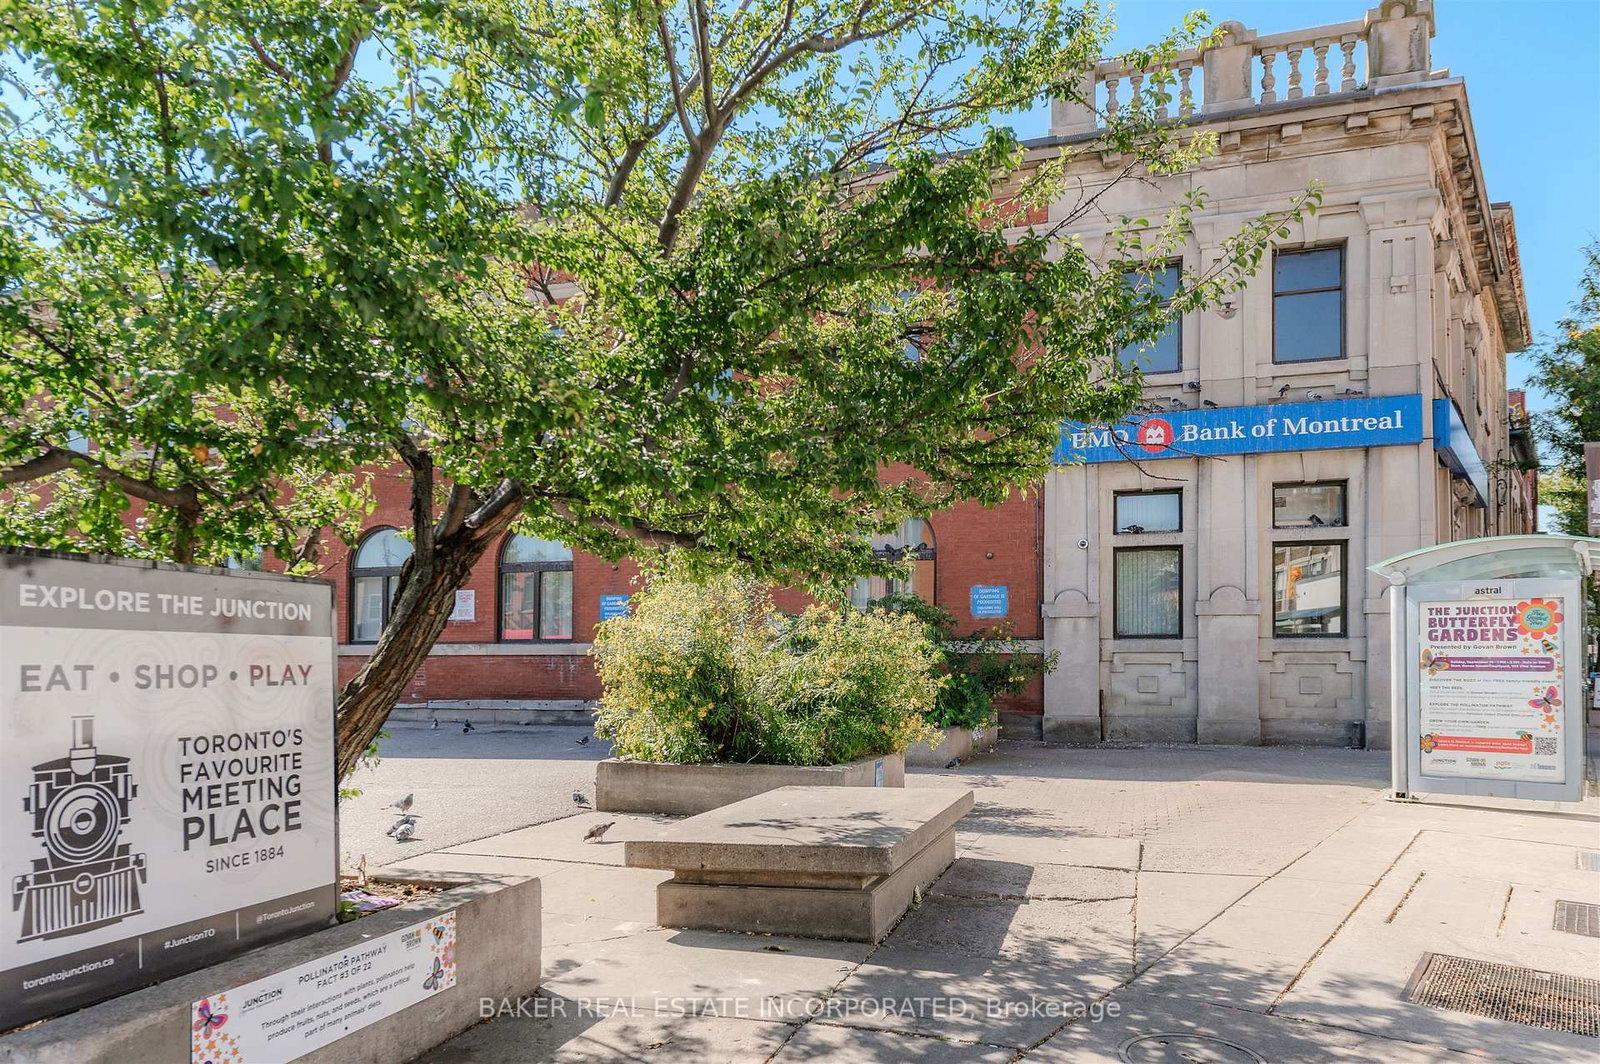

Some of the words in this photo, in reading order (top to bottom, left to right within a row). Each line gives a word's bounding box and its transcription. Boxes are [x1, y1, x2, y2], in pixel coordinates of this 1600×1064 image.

[1182, 421, 1247, 443] Bank
[1252, 418, 1279, 437] of
[1283, 410, 1403, 435] Montreal
[19, 583, 150, 613] EXPLORE
[157, 593, 204, 616] THE
[210, 598, 312, 622] JUNCTION
[1474, 587, 1502, 595] astral
[1428, 607, 1450, 616] THE
[1456, 606, 1517, 616] JUNCTION
[1428, 616, 1517, 628] BUTTERFLY
[1428, 628, 1518, 642] GARDENS
[20, 664, 95, 692] EAT
[134, 664, 218, 690] SHOP
[250, 664, 313, 687] PLAY
[178, 729, 303, 756] TORONTO'S
[180, 752, 302, 783] FAVOURITE
[182, 774, 301, 813] MEETING
[183, 800, 302, 851] PLACE
[206, 852, 250, 874] SINCE
[254, 845, 284, 863] 1884
[255, 900, 316, 924] @TorontoJunction
[164, 928, 216, 951] #JunctionTO
[22, 956, 115, 990] torontojunction.ca
[298, 959, 350, 984] POLLINATOR
[350, 944, 387, 966] PATHWAY
[317, 974, 338, 988] FACT
[340, 970, 349, 980] #3
[350, 964, 362, 976] OF
[363, 962, 372, 972] 22
[242, 988, 282, 1009] JUNCTION
[261, 1014, 290, 1030] Through
[268, 1024, 296, 1041] produce
